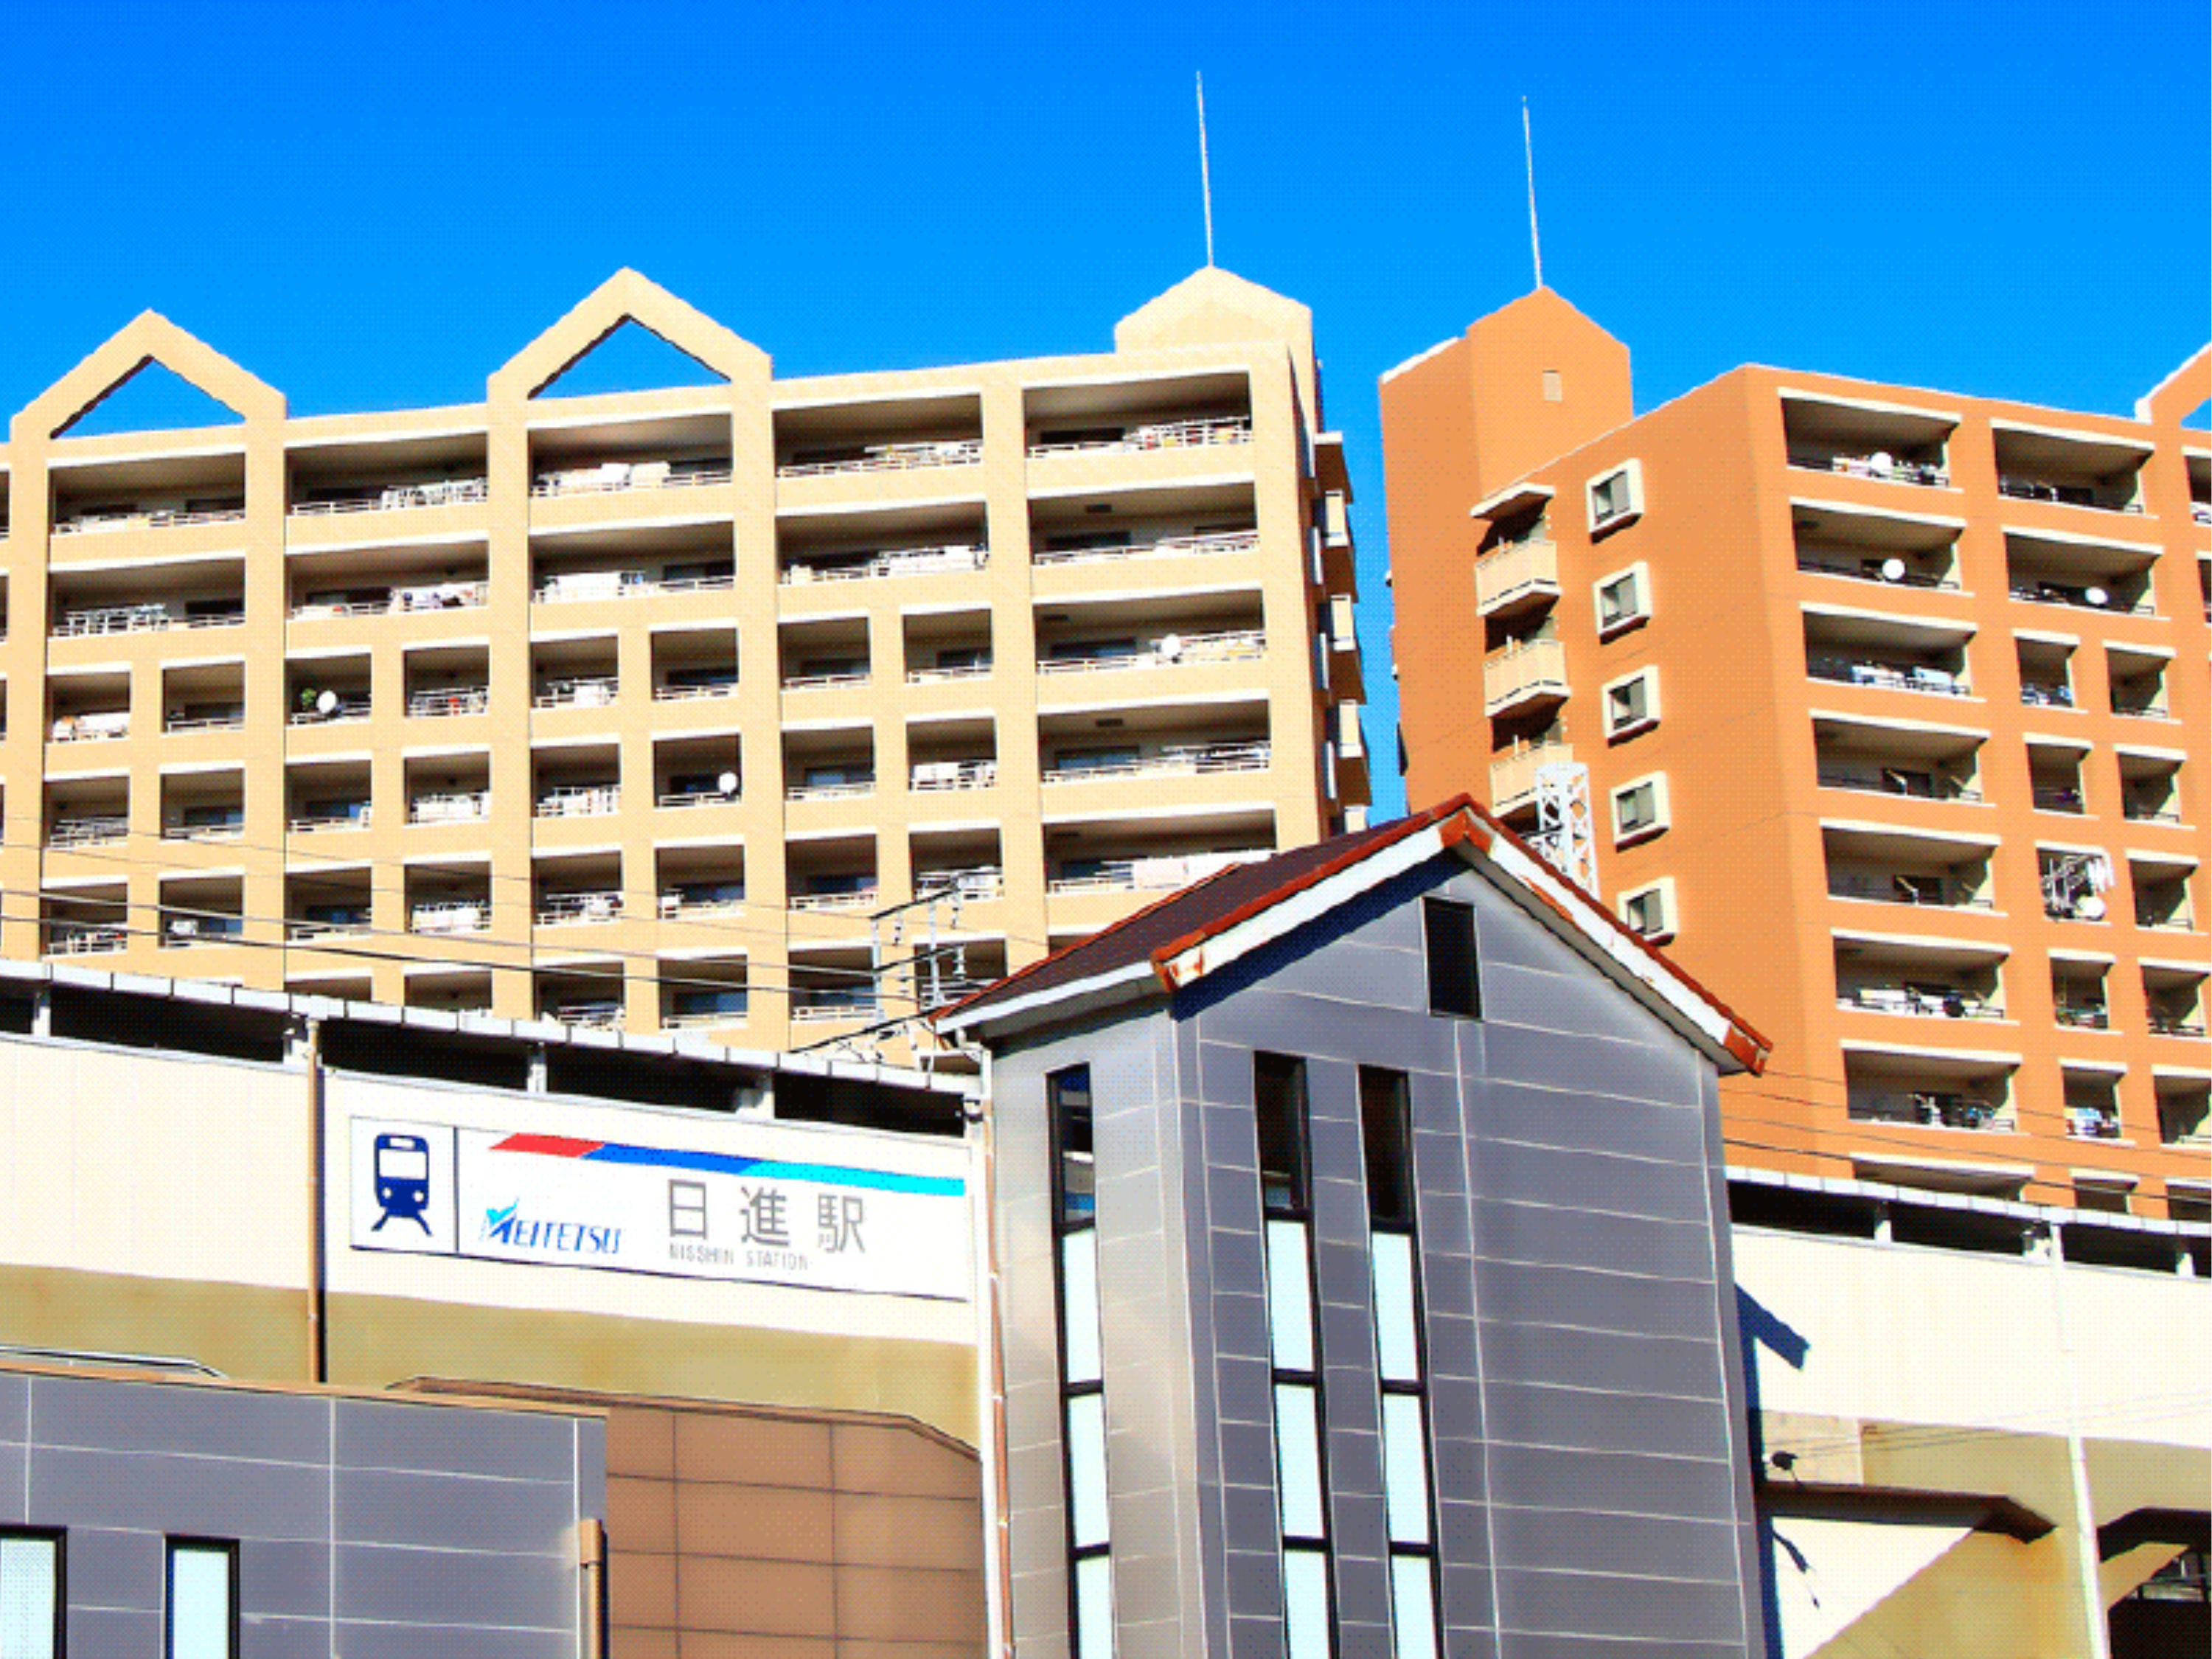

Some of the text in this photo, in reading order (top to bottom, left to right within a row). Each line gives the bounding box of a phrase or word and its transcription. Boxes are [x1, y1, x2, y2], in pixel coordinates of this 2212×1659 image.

[480, 1199, 622, 1254] MEITETSU
[668, 1179, 864, 1253] 日進駅
[669, 1243, 808, 1270] NISSHIN STATION
